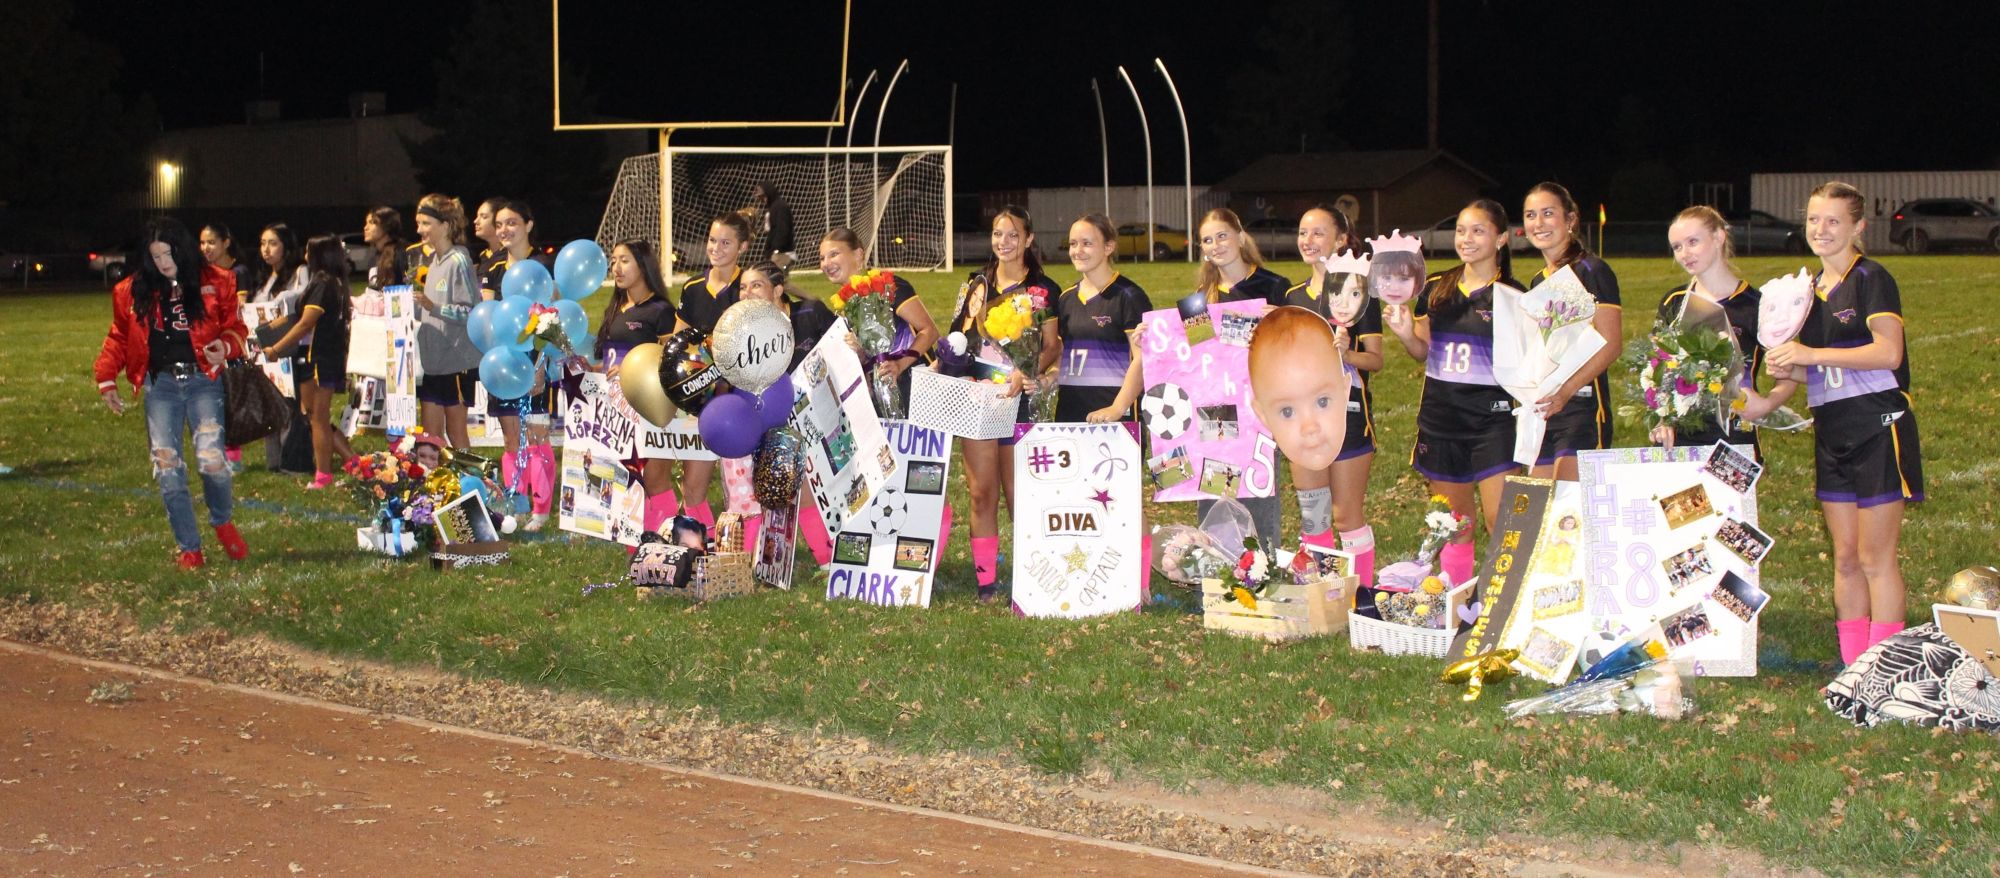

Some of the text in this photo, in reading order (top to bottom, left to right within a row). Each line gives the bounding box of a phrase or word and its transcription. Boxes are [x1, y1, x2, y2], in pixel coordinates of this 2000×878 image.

[724, 332, 792, 370] cheers
[1068, 348, 1089, 377] 17
[1442, 341, 1471, 374] 13
[565, 420, 612, 449] LOPEZ
[594, 397, 636, 445] KARINA
[1027, 445, 1071, 474] #3
[1244, 432, 1276, 499] 5
[1623, 446, 1701, 464] SENIOR
[1048, 512, 1098, 532] DIVA
[829, 569, 899, 607] CLARK
[900, 574, 925, 608] #1
[1023, 550, 1070, 602] SENIOR
[1080, 546, 1123, 607] CAPTAIN
